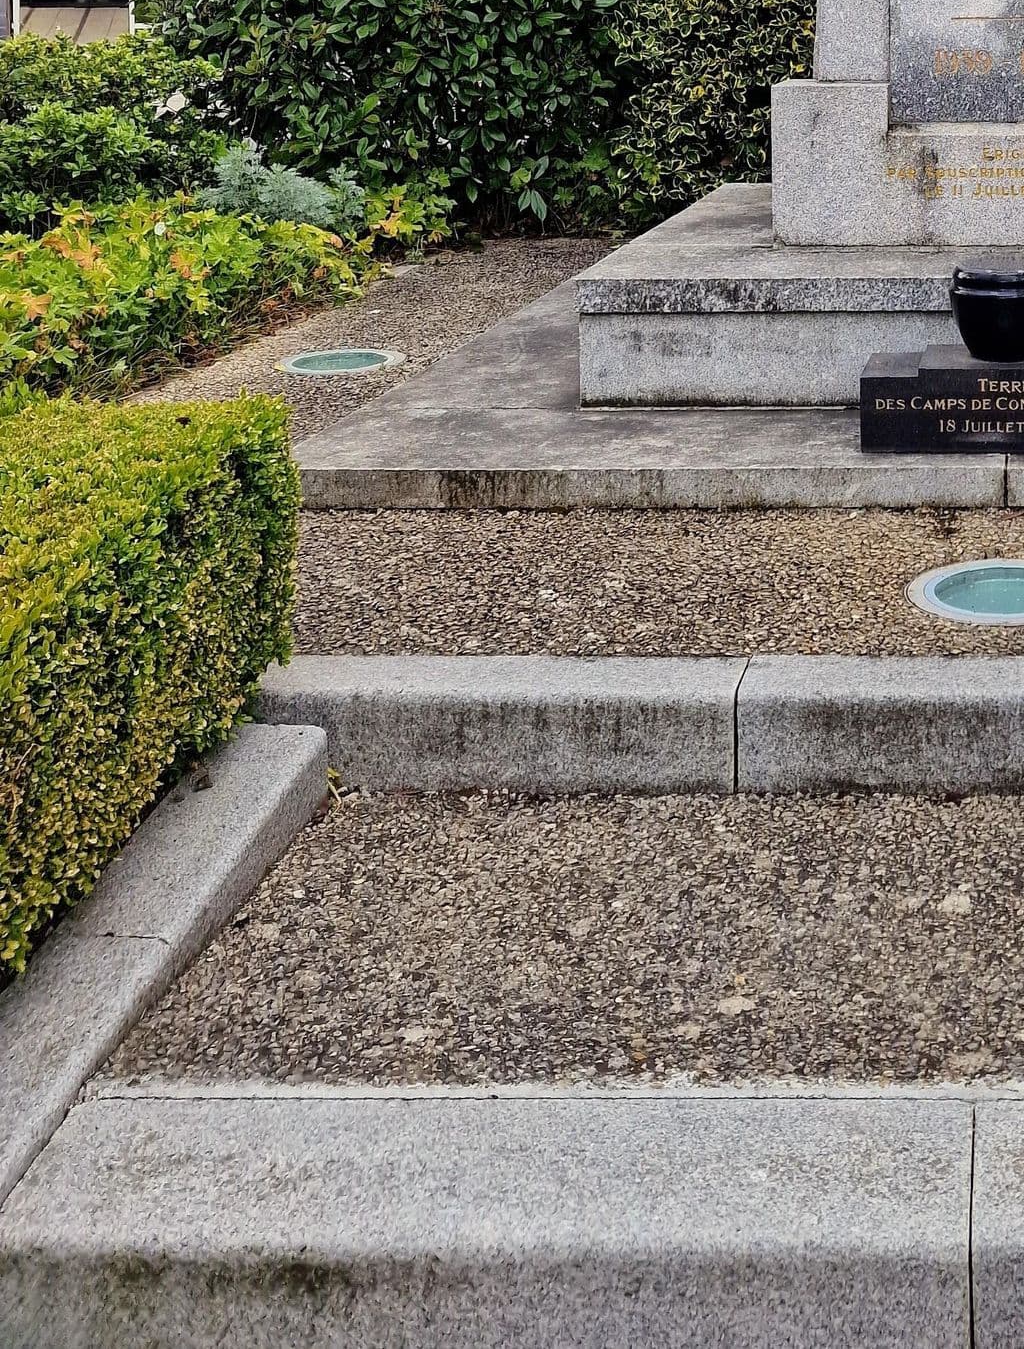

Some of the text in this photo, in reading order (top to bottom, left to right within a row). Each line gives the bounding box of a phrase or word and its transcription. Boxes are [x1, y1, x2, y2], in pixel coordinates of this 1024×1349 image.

[934, 48, 993, 75] 1939
[875, 398, 905, 411] DES
[910, 396, 966, 411] CAMPS
[971, 399, 991, 411] DE
[939, 419, 956, 433] 18
[961, 419, 1024, 433] JUILLET
